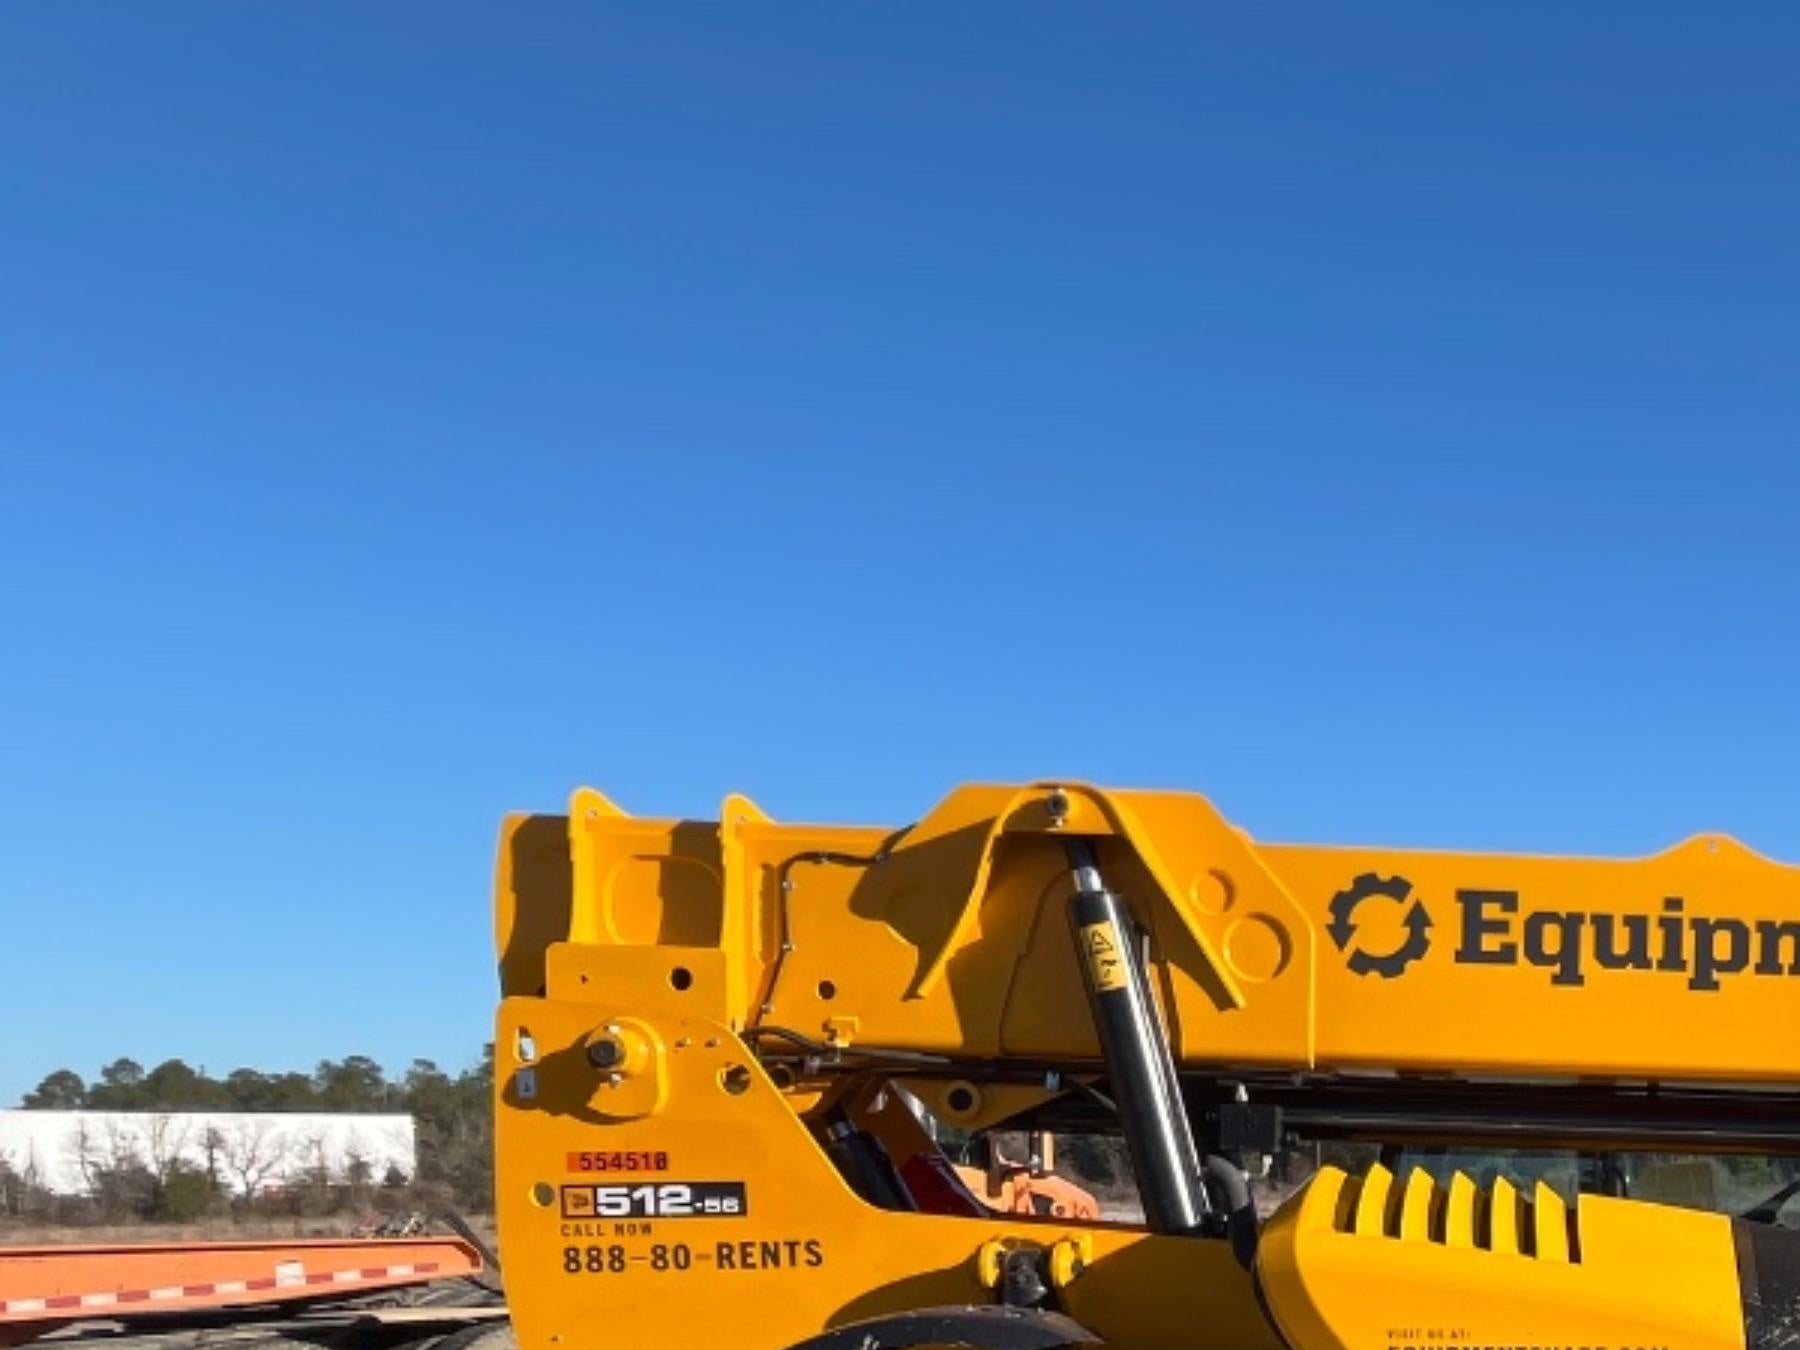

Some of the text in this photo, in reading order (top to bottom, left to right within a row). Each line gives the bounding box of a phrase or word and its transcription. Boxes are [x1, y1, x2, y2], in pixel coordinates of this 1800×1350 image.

[560, 1222, 653, 1237] CALL NOW
[563, 1239, 823, 1274] 888-80-RENTS
